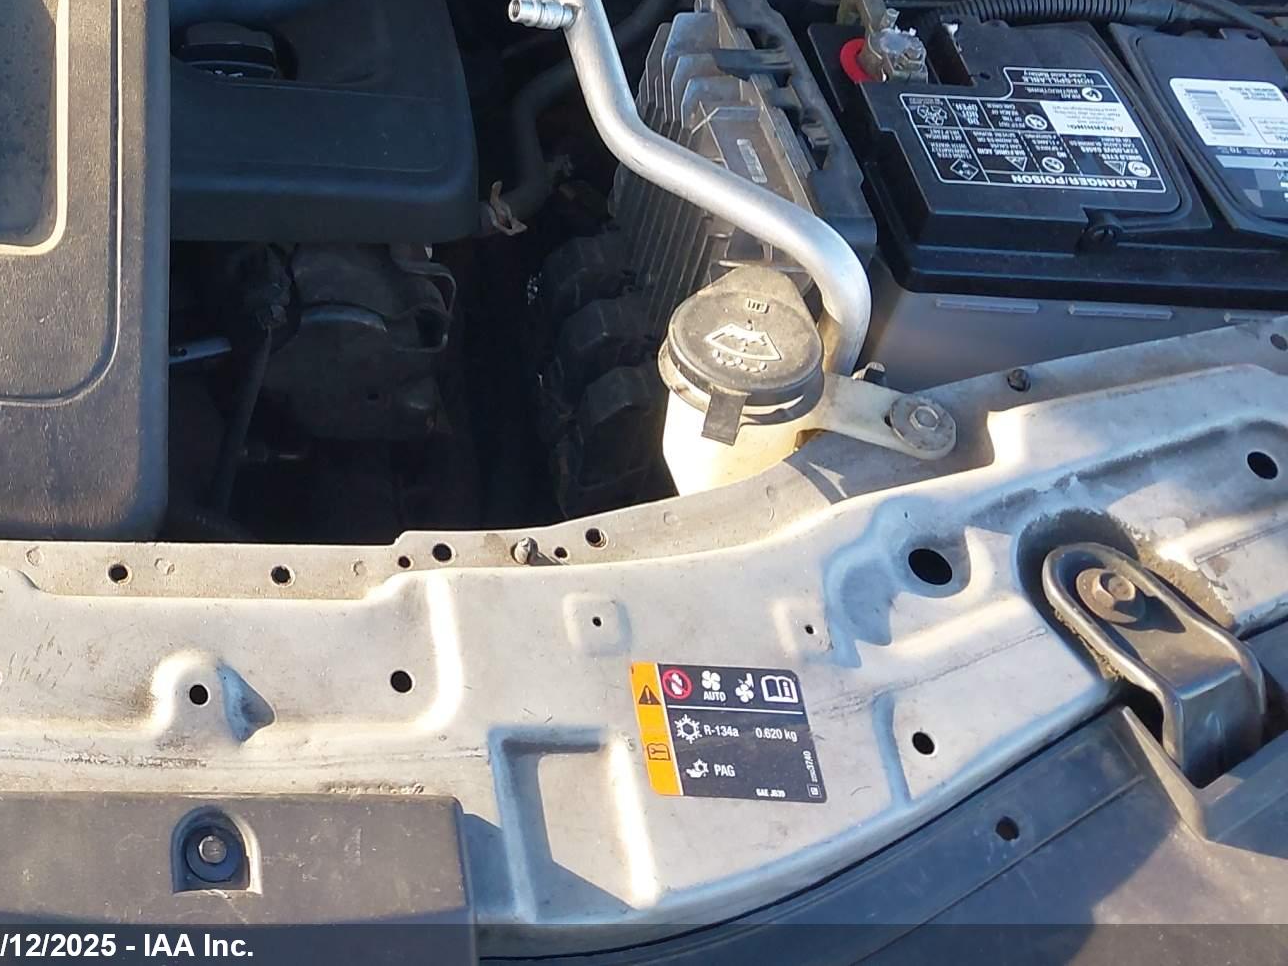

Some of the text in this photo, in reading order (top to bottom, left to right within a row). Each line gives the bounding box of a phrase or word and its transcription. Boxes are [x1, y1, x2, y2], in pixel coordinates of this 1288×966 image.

[1010, 174, 1127, 187] DANGER/POISON
[703, 691, 726, 702] AUTO
[704, 724, 797, 742] R-134a 0.620 kg
[714, 763, 735, 777] PAG
